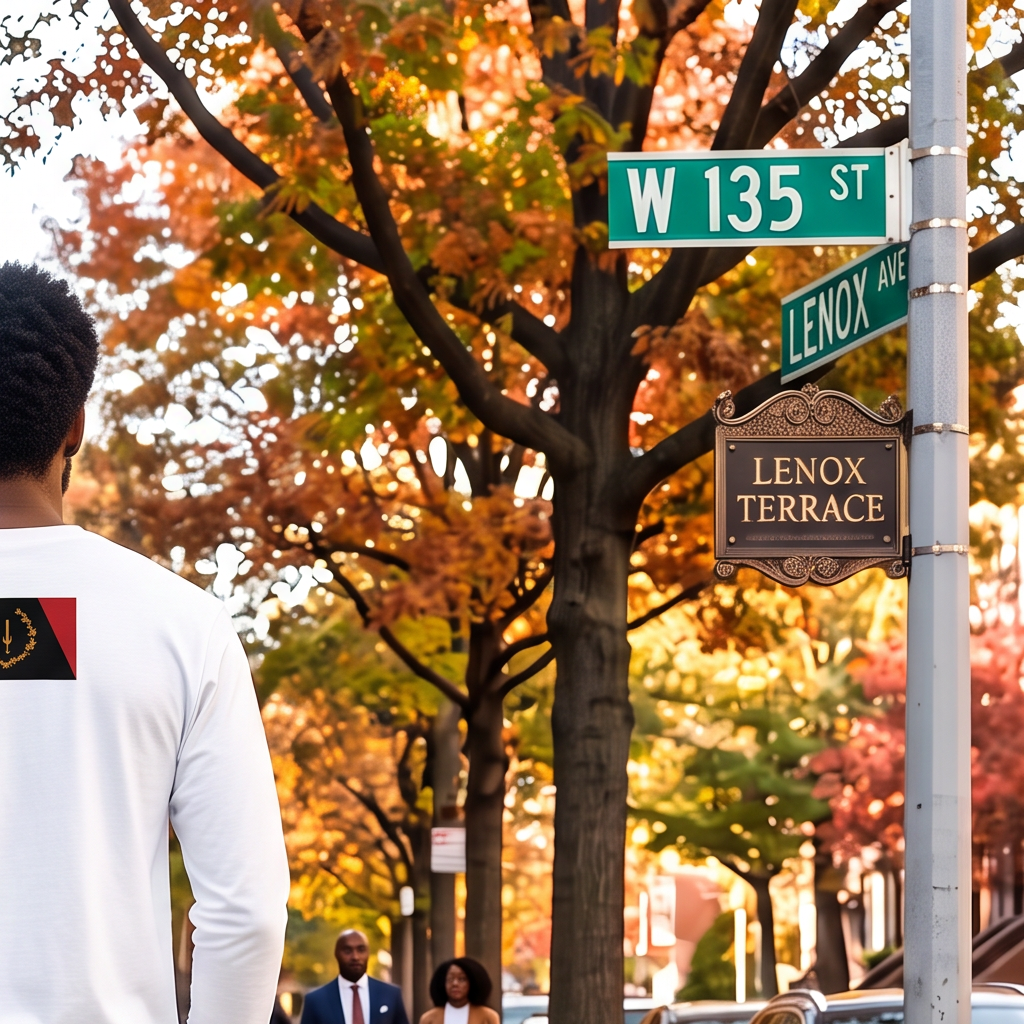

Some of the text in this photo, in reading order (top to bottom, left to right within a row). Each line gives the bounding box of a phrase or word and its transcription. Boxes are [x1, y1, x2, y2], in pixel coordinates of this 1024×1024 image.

[627, 163, 869, 233] W 135 ST
[789, 247, 907, 365] LENOX AVE
[752, 456, 867, 486] LENOX
[736, 493, 885, 523] TERRACE
